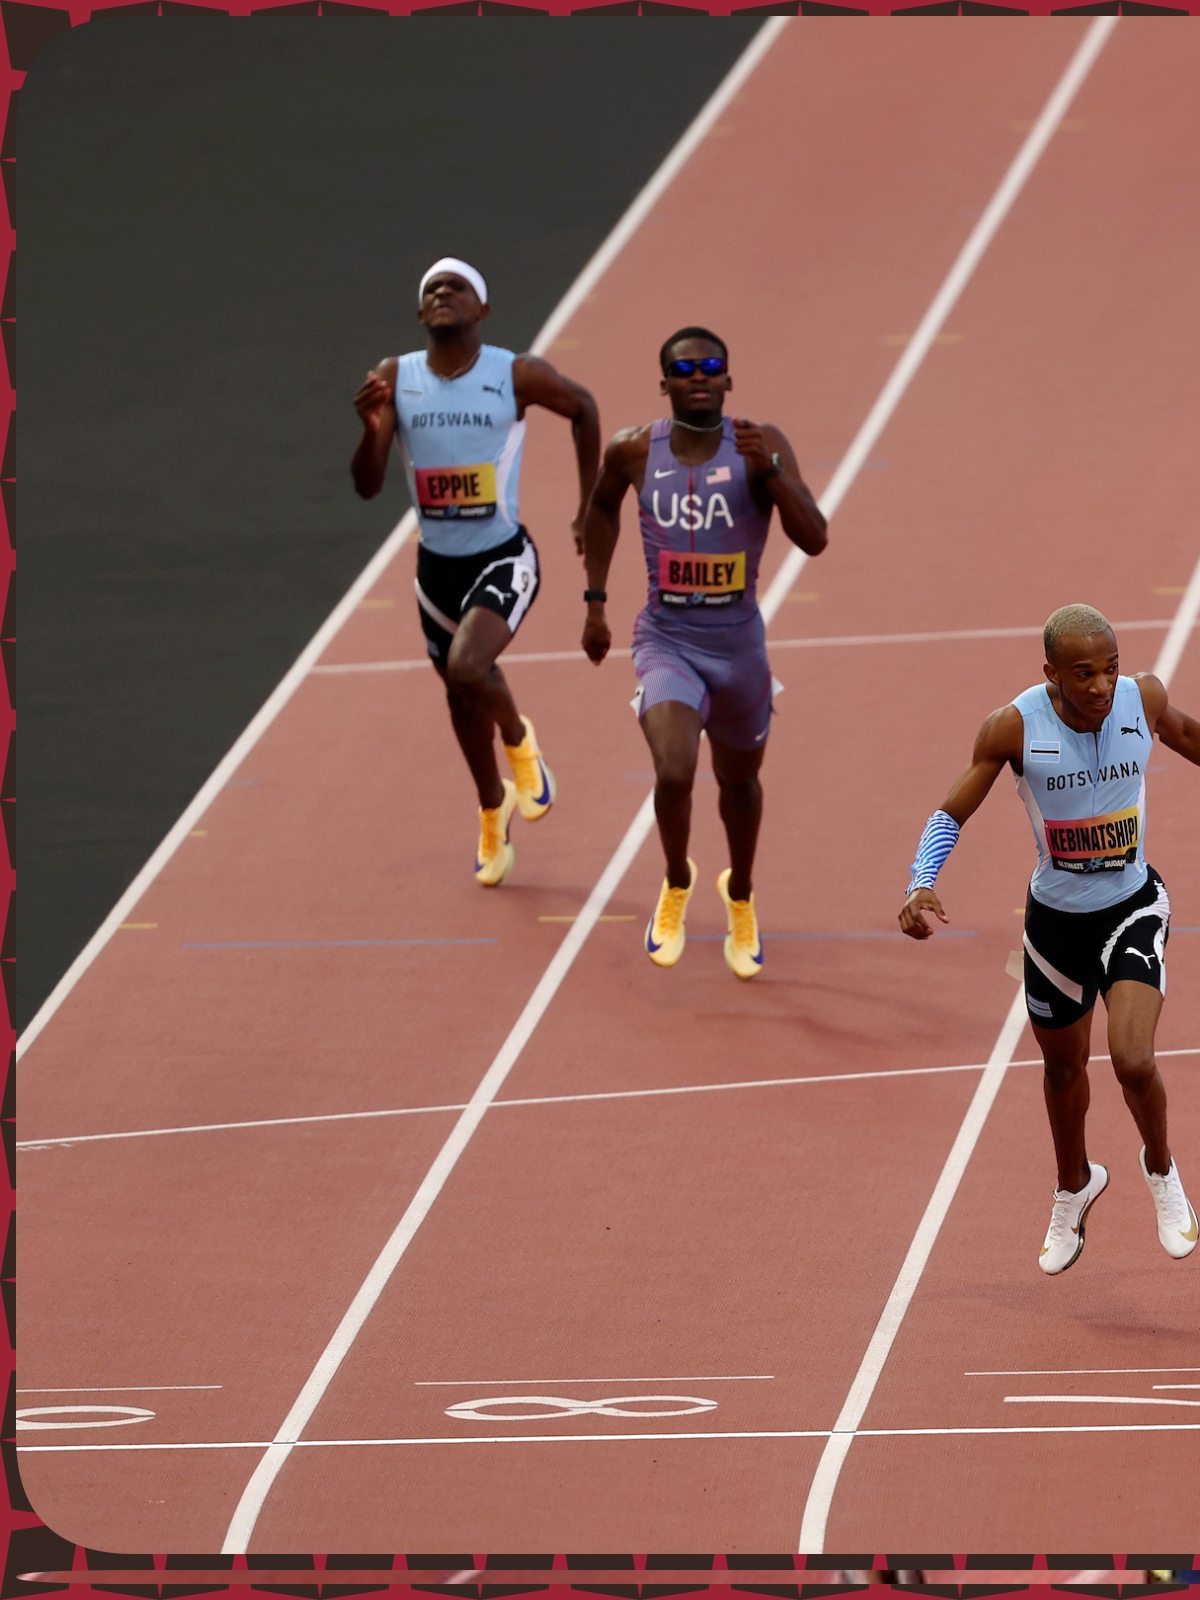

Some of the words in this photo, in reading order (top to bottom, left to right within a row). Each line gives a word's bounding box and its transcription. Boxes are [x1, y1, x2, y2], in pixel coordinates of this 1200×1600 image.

[411, 412, 493, 429] BOTSWANA
[427, 472, 480, 499] EPPIE
[652, 489, 734, 531] USA
[669, 560, 736, 587] BAILEY
[1046, 760, 1140, 791] BOTSWANA
[1049, 815, 1138, 852] KEBINATSHIPI
[444, 1396, 718, 1420] 8
